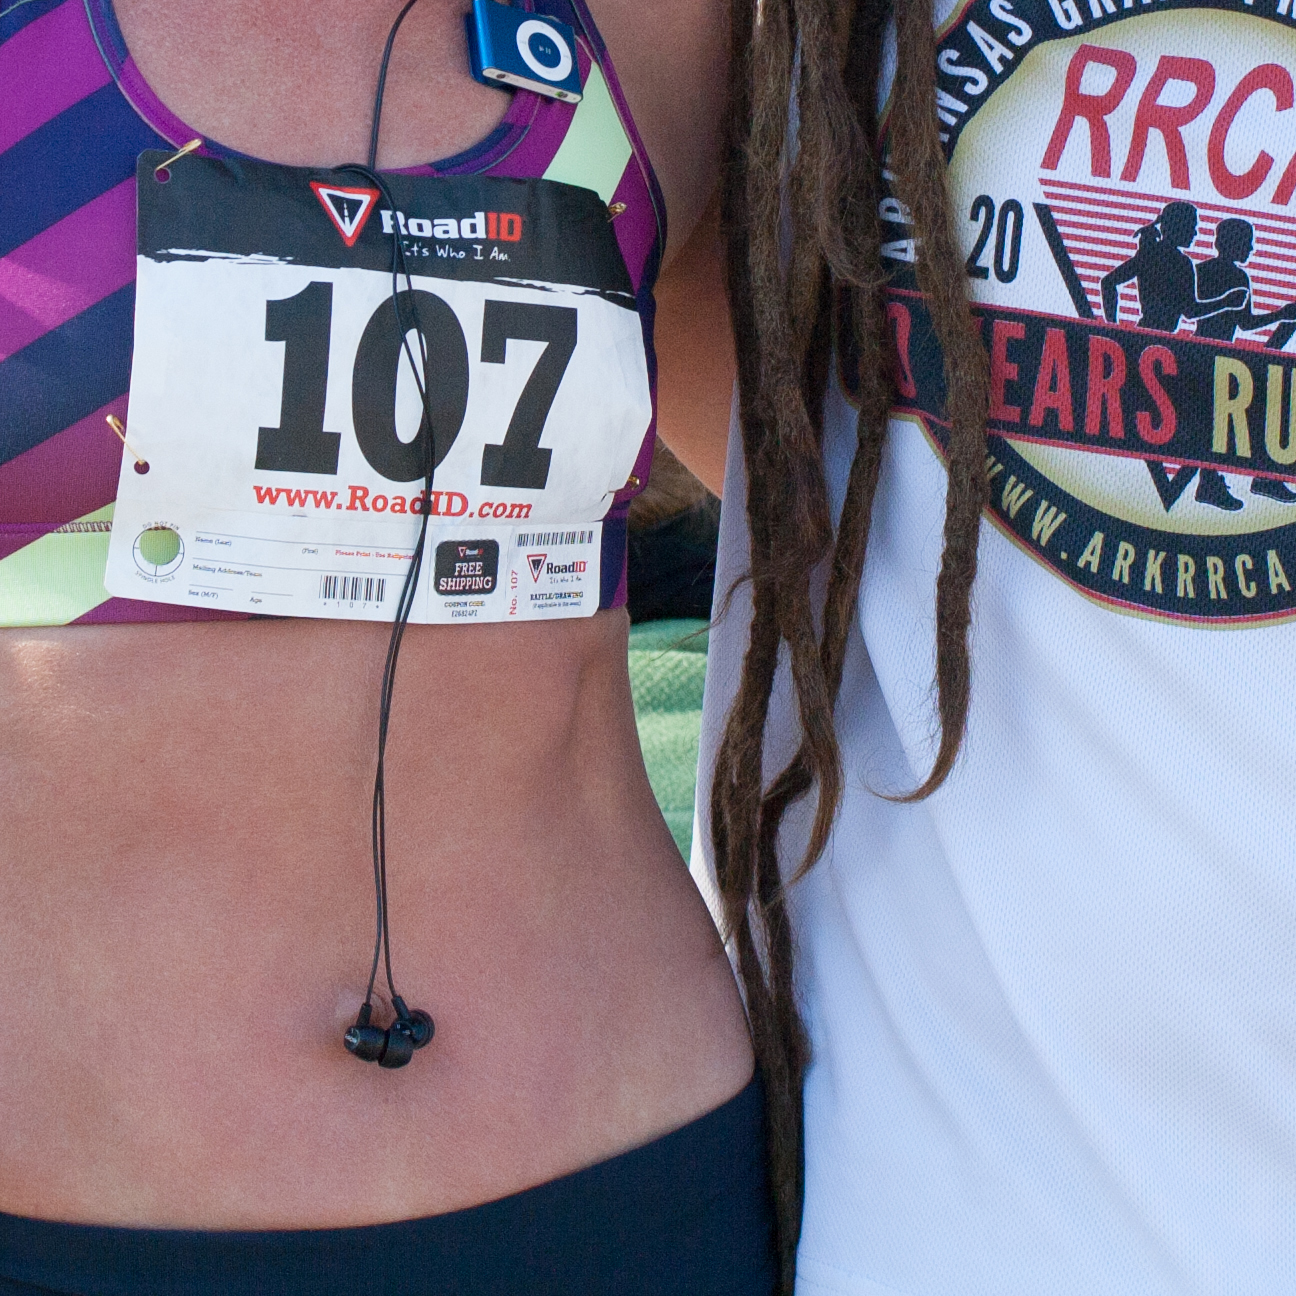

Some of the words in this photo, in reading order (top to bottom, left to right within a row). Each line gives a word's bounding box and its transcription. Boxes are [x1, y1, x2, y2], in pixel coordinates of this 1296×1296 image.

[380, 209, 523, 242] RoadID
[967, 194, 1023, 285] 20
[435, 244, 466, 259] Who
[473, 244, 484, 260] I
[253, 280, 579, 490] 107
[974, 316, 1179, 446] EARS
[253, 484, 534, 520] www.RoadID.com
[454, 561, 483, 576] FREE
[546, 560, 587, 575] RoadID
[439, 576, 492, 591] SHIPPING
[510, 569, 519, 591] 107
[509, 595, 518, 616] No.
